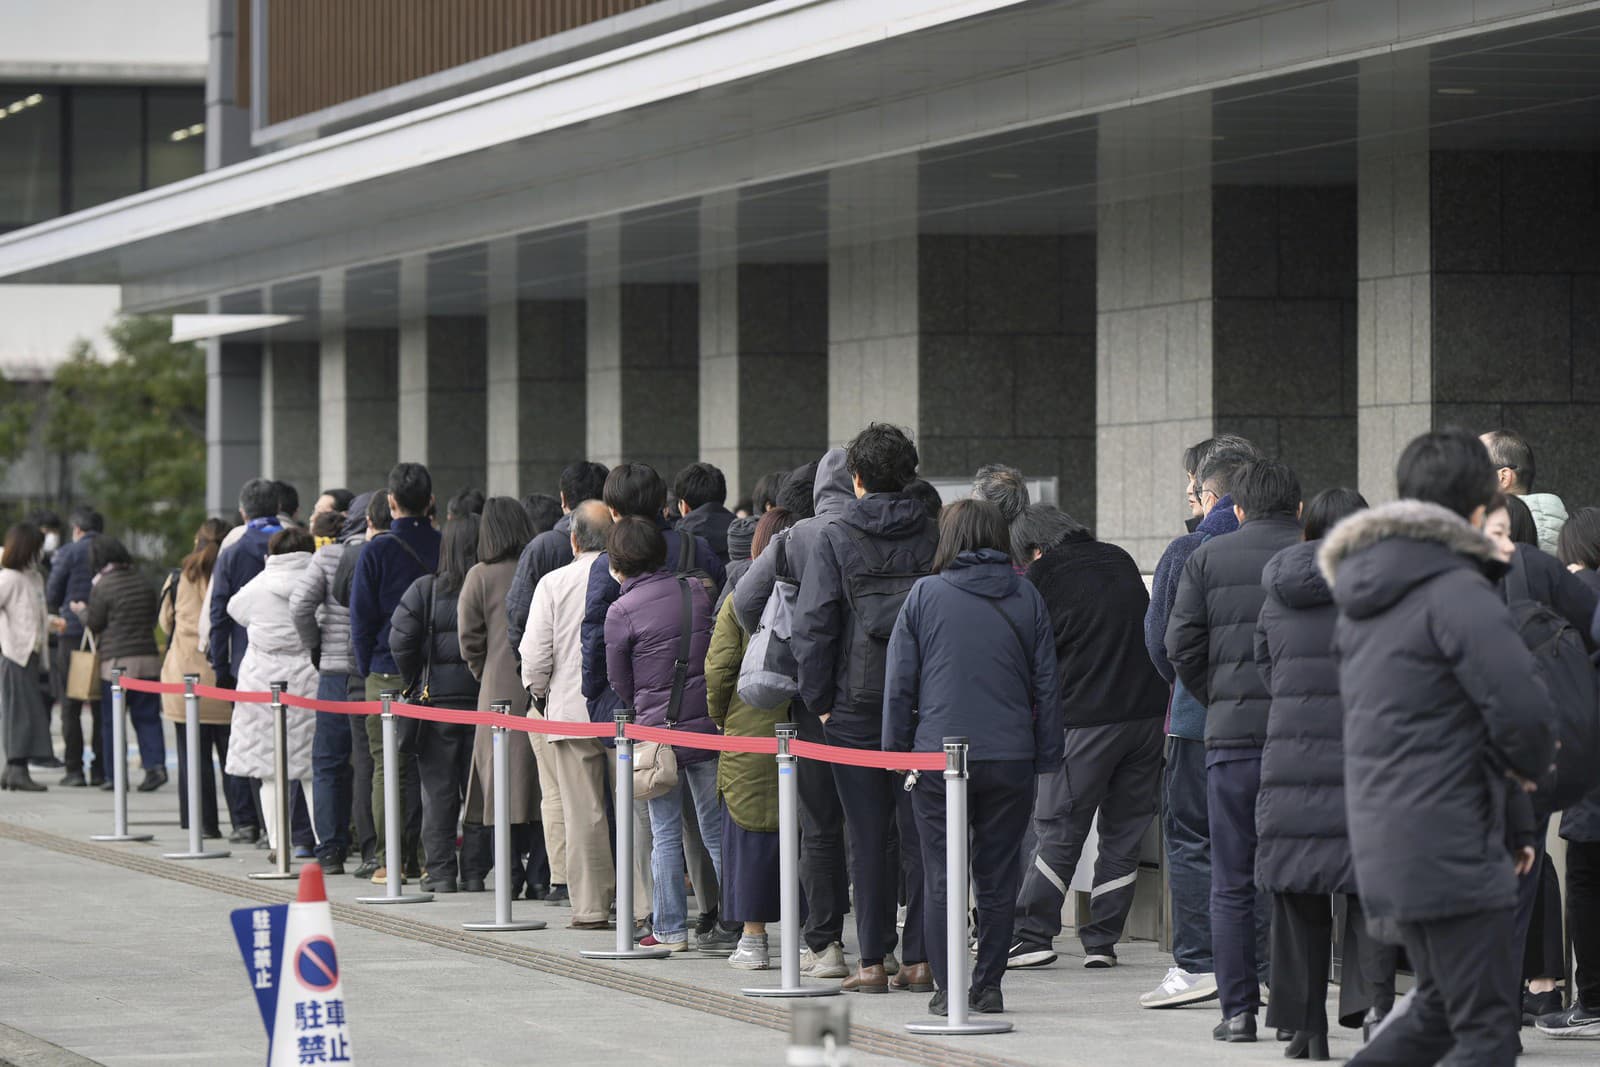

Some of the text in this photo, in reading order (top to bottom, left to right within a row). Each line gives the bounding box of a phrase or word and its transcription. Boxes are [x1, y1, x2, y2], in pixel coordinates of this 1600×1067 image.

[252, 909, 272, 988] 駐車禁止
[295, 999, 345, 1030] 駐車
[297, 1033, 350, 1064] 禁止
